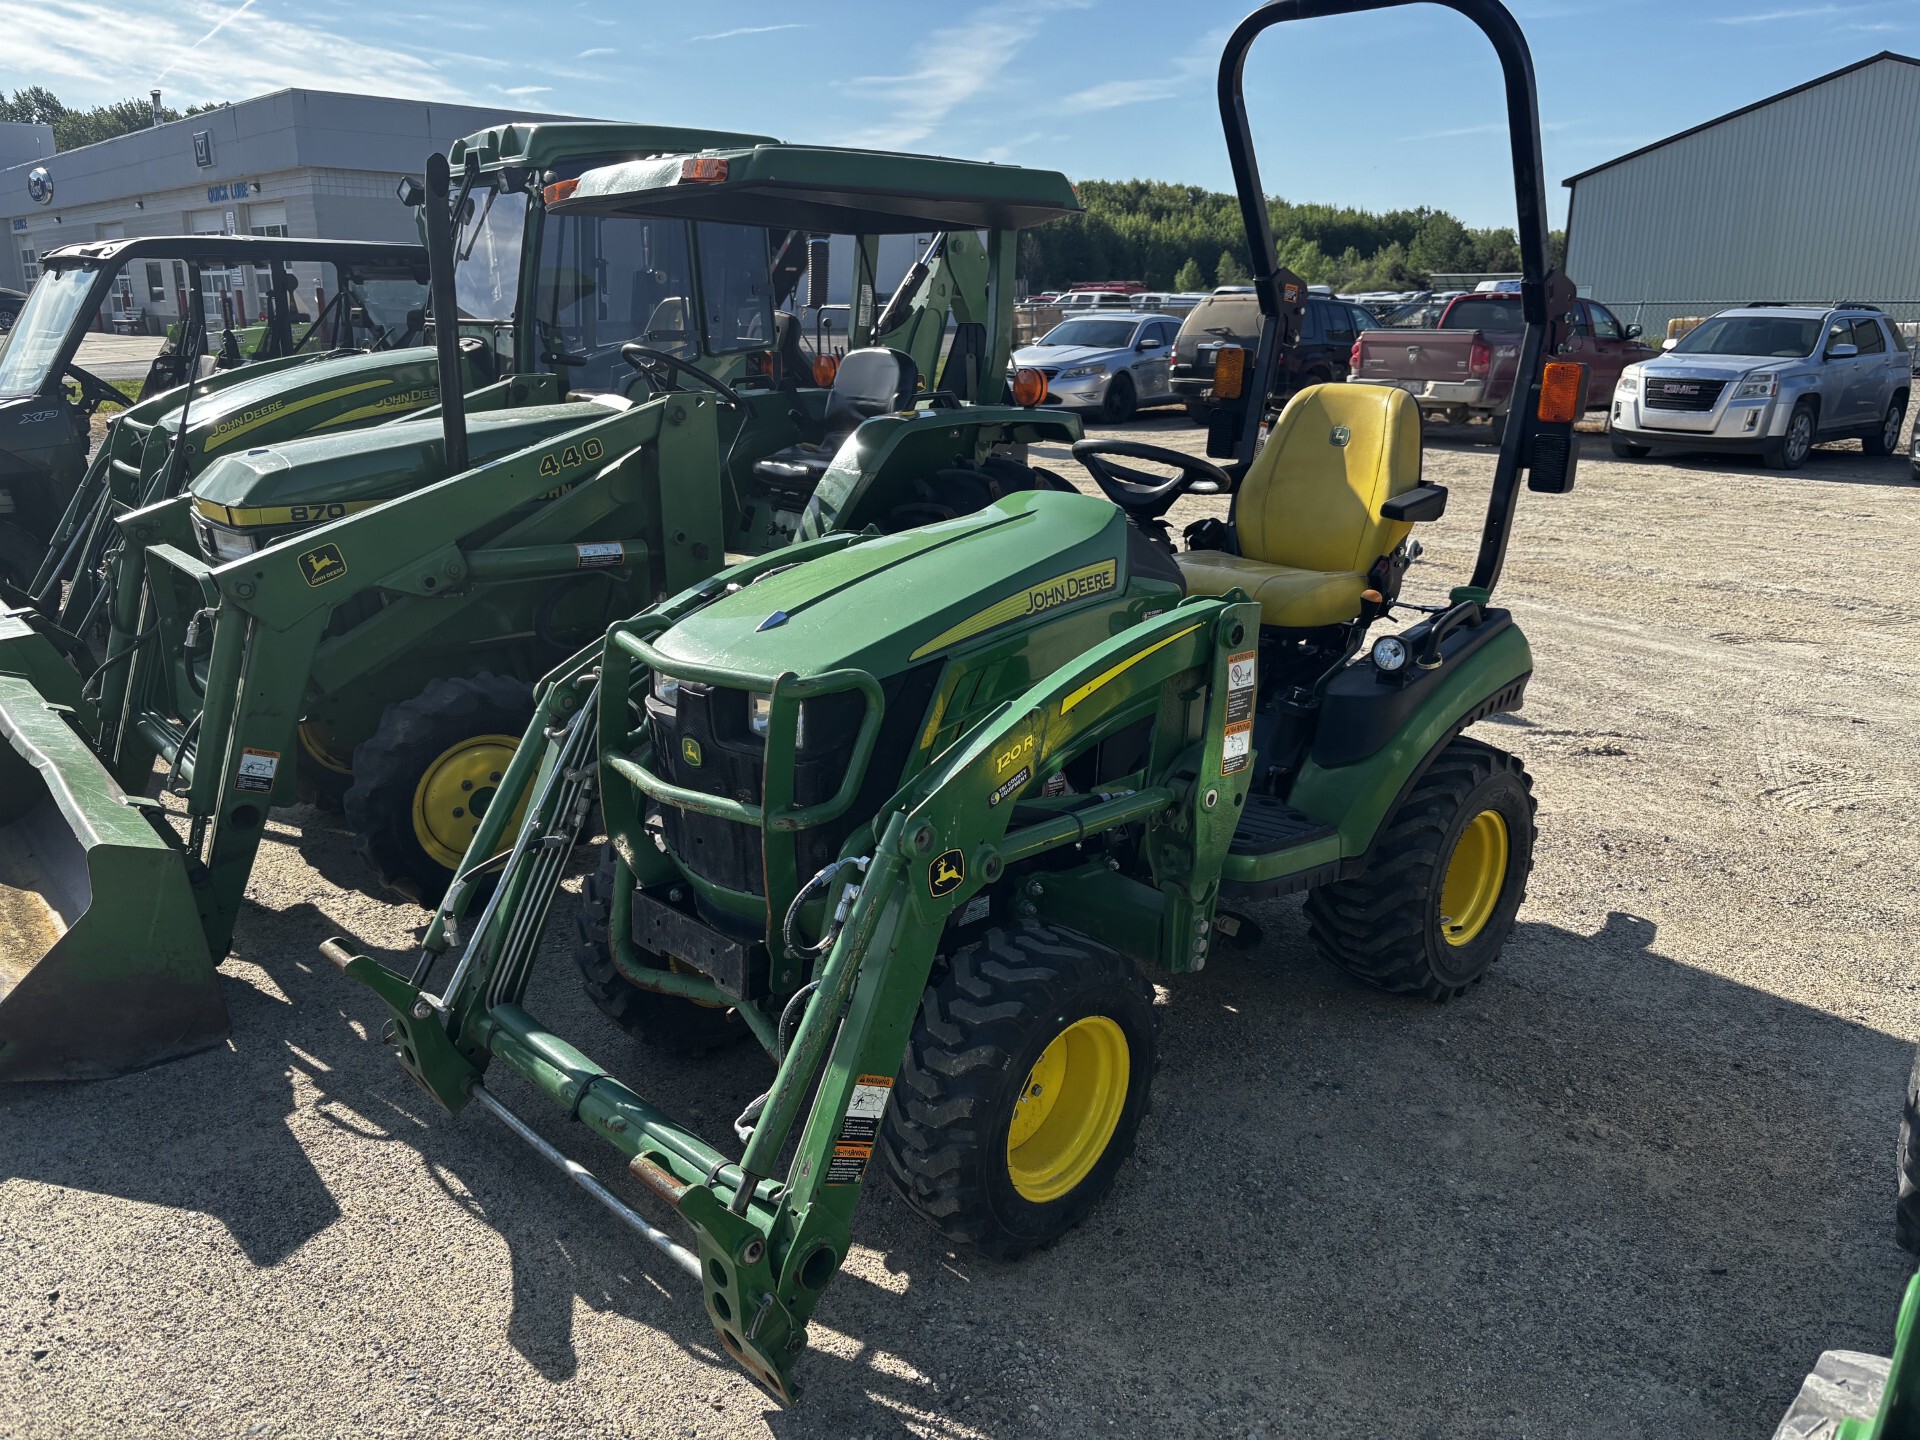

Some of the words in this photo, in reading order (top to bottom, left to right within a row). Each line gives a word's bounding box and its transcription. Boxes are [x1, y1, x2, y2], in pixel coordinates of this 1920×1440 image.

[208, 184, 229, 203] QUICK
[230, 181, 249, 199] LUBE
[375, 392, 411, 408] JOHN
[410, 388, 438, 402] DEE
[1663, 384, 1700, 395] GMC
[18, 409, 59, 425] XP
[211, 416, 244, 437] JOHN
[243, 400, 285, 421] DEERE
[539, 437, 604, 476] 440
[290, 503, 346, 521] 870
[311, 575, 326, 585] JOHN
[326, 567, 344, 578] DEERE
[1025, 584, 1066, 612] JOHN
[1066, 571, 1112, 597] DEERE
[997, 744, 1022, 774] 120
[1023, 734, 1034, 752] R
[1000, 774, 1028, 798] EQUIPMENT
[1007, 768, 1027, 786] COUNTY
[866, 1077, 890, 1085] WARNING
